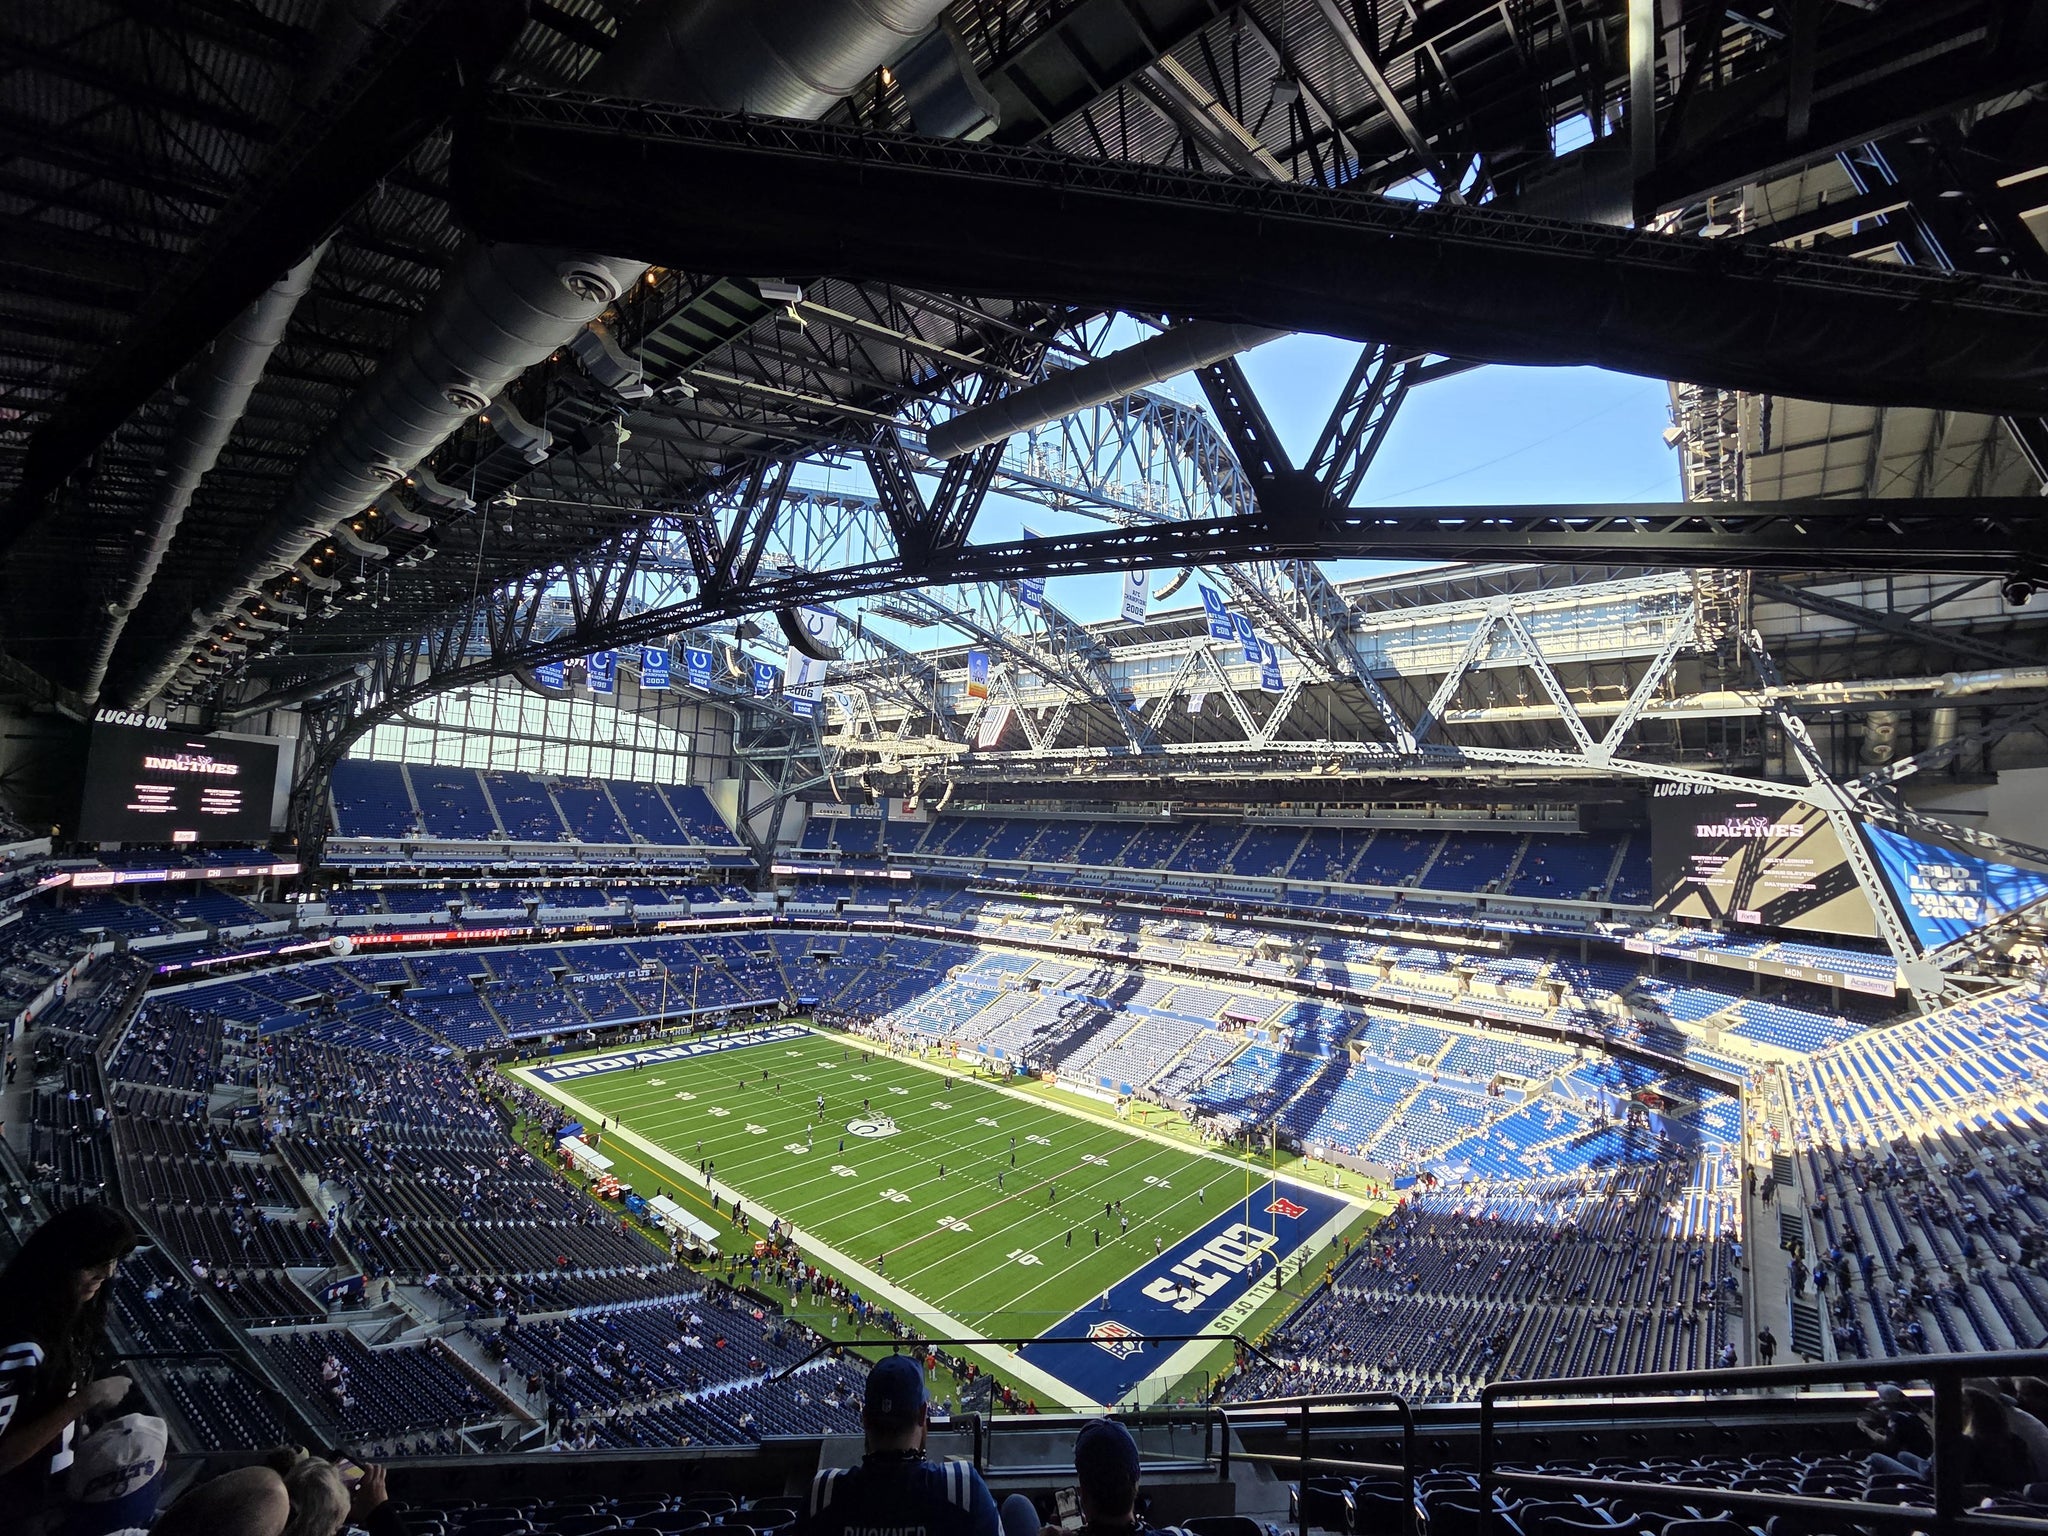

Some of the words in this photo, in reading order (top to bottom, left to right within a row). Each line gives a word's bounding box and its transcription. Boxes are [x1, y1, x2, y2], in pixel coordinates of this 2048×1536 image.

[1126, 603, 1144, 616] 2009
[94, 708, 144, 727] LUCAS
[145, 717, 168, 730] OIL
[144, 757, 239, 775] INACTIVES
[1653, 783, 1692, 798] LUCAS
[855, 808, 884, 817] LIGHT
[1696, 824, 1805, 838] INACTIVES
[171, 871, 186, 879] PHI
[1917, 864, 1970, 879] BUD
[1909, 875, 1981, 892] LIGHT
[1910, 893, 1982, 908] PARTY
[1917, 907, 1978, 920] ZONE
[1661, 946, 1680, 956] LEAGUE
[1680, 949, 1697, 959] STATS
[1703, 952, 1718, 964] ARI
[1784, 967, 1802, 978] MON
[1817, 973, 1834, 983] 8:15
[1850, 977, 1889, 992] Academy
[544, 1025, 806, 1080] INDIANAPOLIS
[784, 1143, 810, 1155] 50
[1081, 1153, 1107, 1166] 20
[830, 1165, 855, 1177] 40
[1143, 1175, 1169, 1188] 10
[879, 1188, 907, 1203] 30
[937, 1215, 970, 1232] 20
[1006, 1248, 1040, 1266] 10
[1142, 1223, 1280, 1314] COLTS
[1247, 1281, 1277, 1301] ALL
[1233, 1300, 1254, 1316] OF
[1213, 1316, 1238, 1332] US
